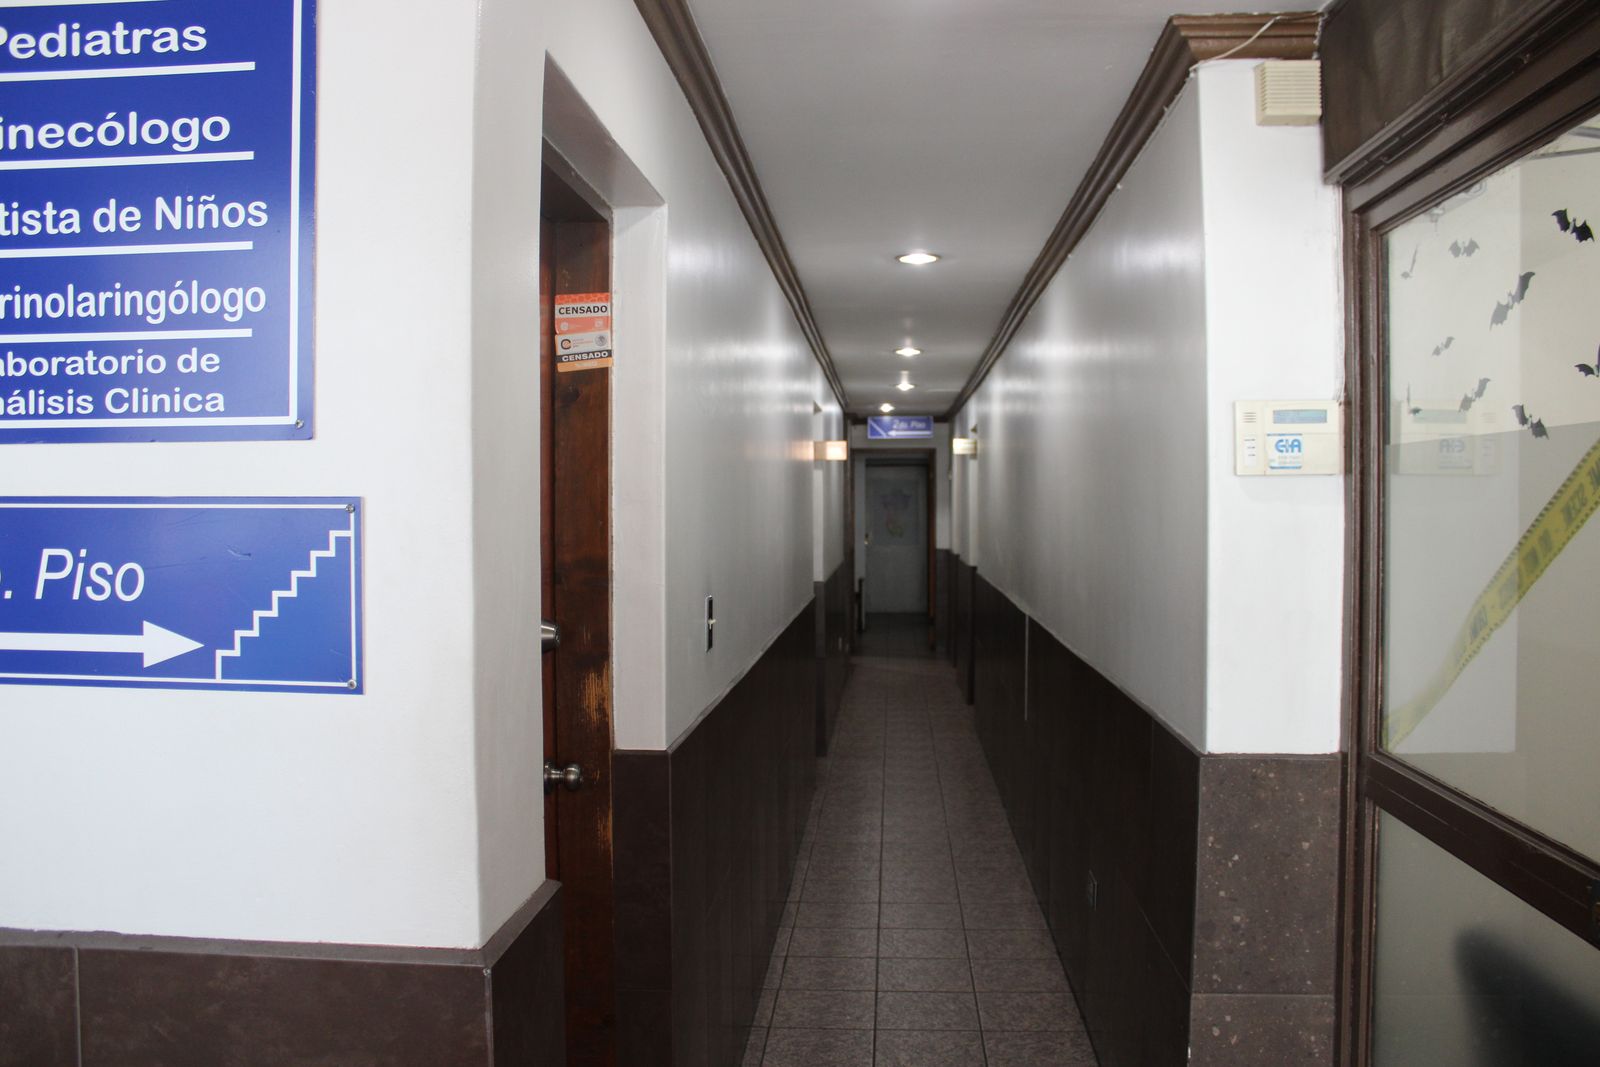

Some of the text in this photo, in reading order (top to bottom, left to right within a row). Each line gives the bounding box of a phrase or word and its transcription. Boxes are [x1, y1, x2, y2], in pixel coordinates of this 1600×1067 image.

[92, 198, 142, 233] de
[154, 194, 269, 231] Niños
[0, 280, 266, 324] rinolaringólogo
[558, 305, 608, 315] CENSADO
[0, 347, 221, 377] boratorio de
[562, 351, 609, 362] CENSADO
[0, 386, 225, 416] álisis Clinica
[34, 548, 145, 602] Piso
